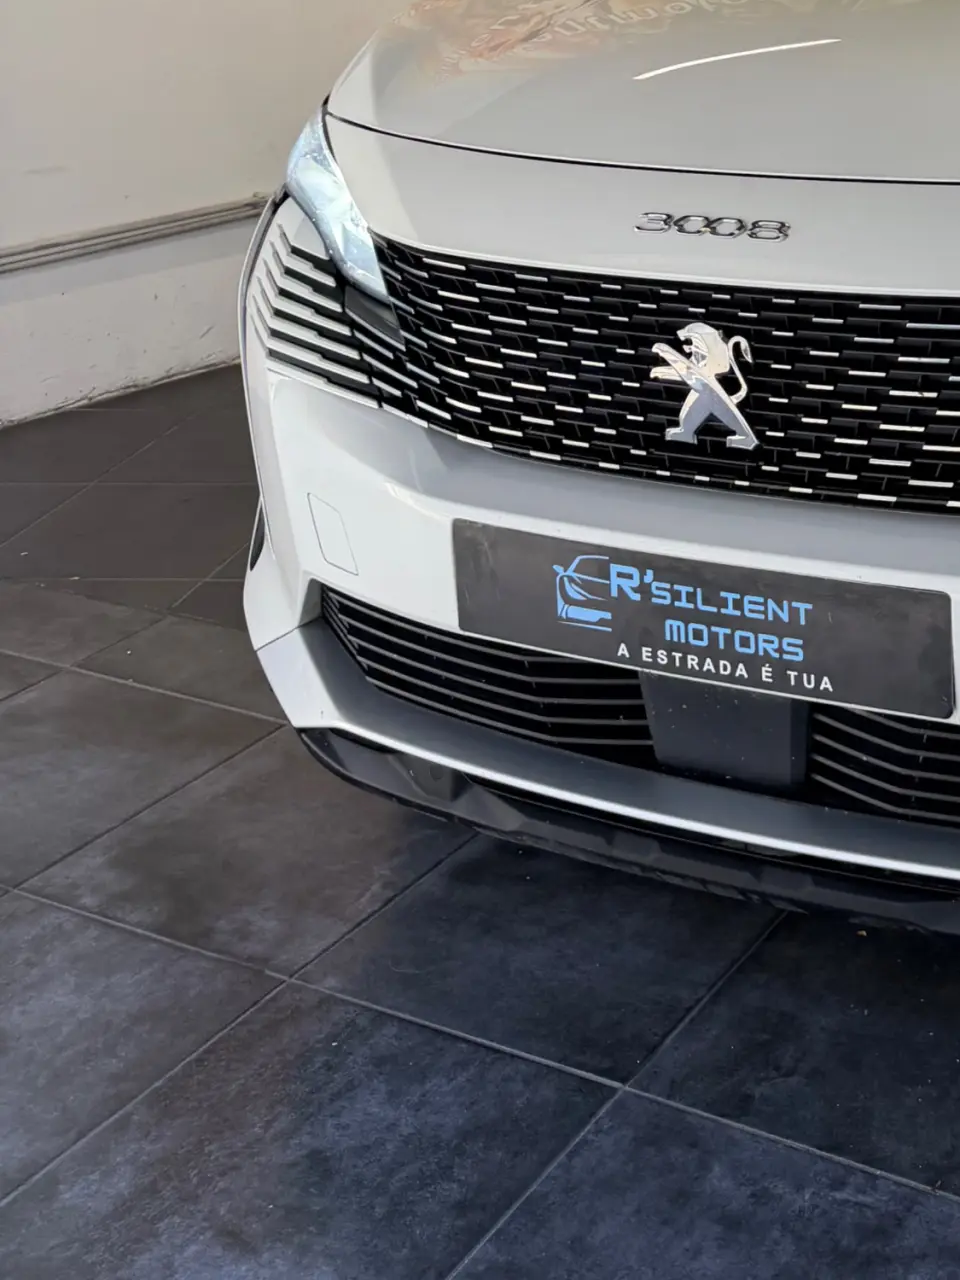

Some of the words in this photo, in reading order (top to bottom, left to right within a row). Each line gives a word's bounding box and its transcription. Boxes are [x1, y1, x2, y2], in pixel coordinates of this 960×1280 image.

[634, 212, 791, 243] 3008
[609, 563, 813, 626] R'SILIENT
[664, 619, 804, 662] MOTORS
[617, 643, 630, 658] A
[641, 646, 749, 679] ESTRADA
[761, 663, 773, 682] É
[786, 670, 833, 692] TUA
